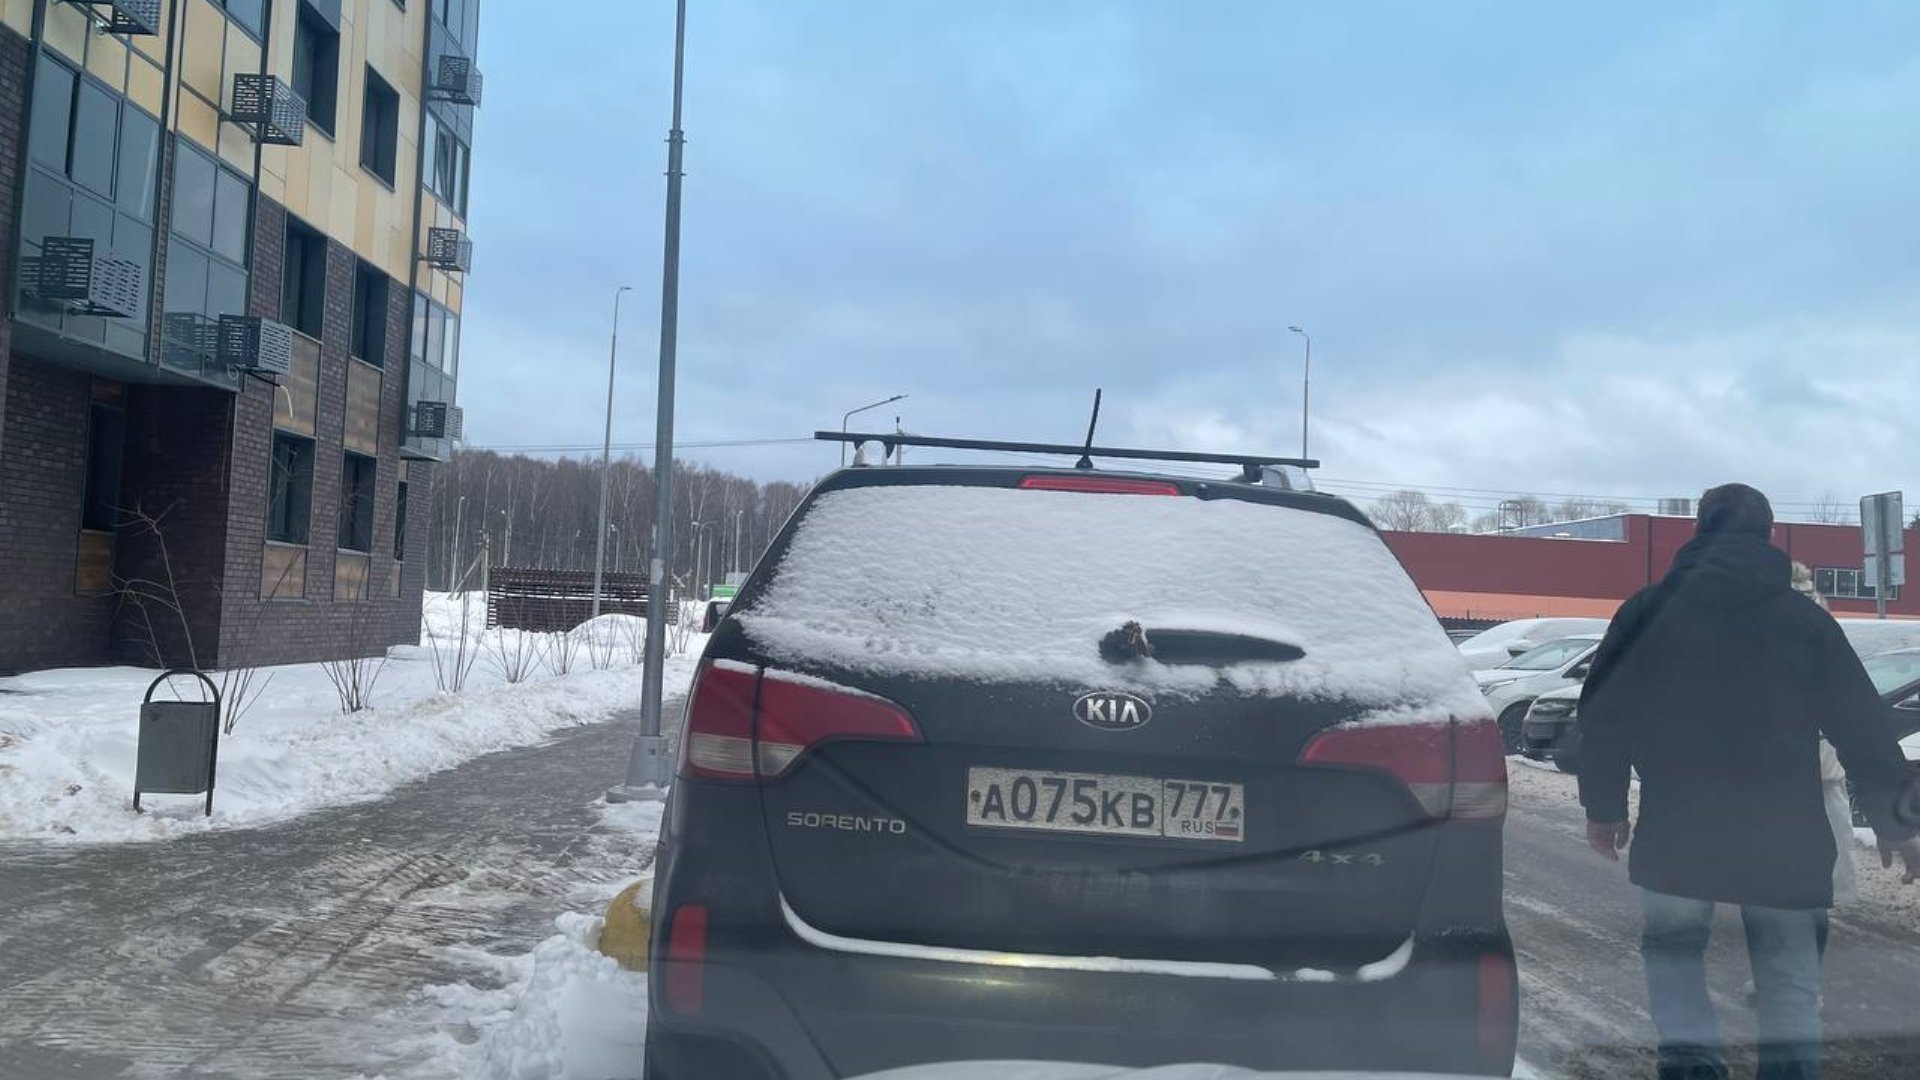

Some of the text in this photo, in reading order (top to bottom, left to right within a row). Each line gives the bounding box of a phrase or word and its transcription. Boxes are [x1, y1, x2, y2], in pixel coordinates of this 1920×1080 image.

[1086, 698, 1140, 723] KIA
[1166, 782, 1231, 821] 777
[786, 812, 906, 834] SORENTO
[1181, 819, 1215, 834] RUS
